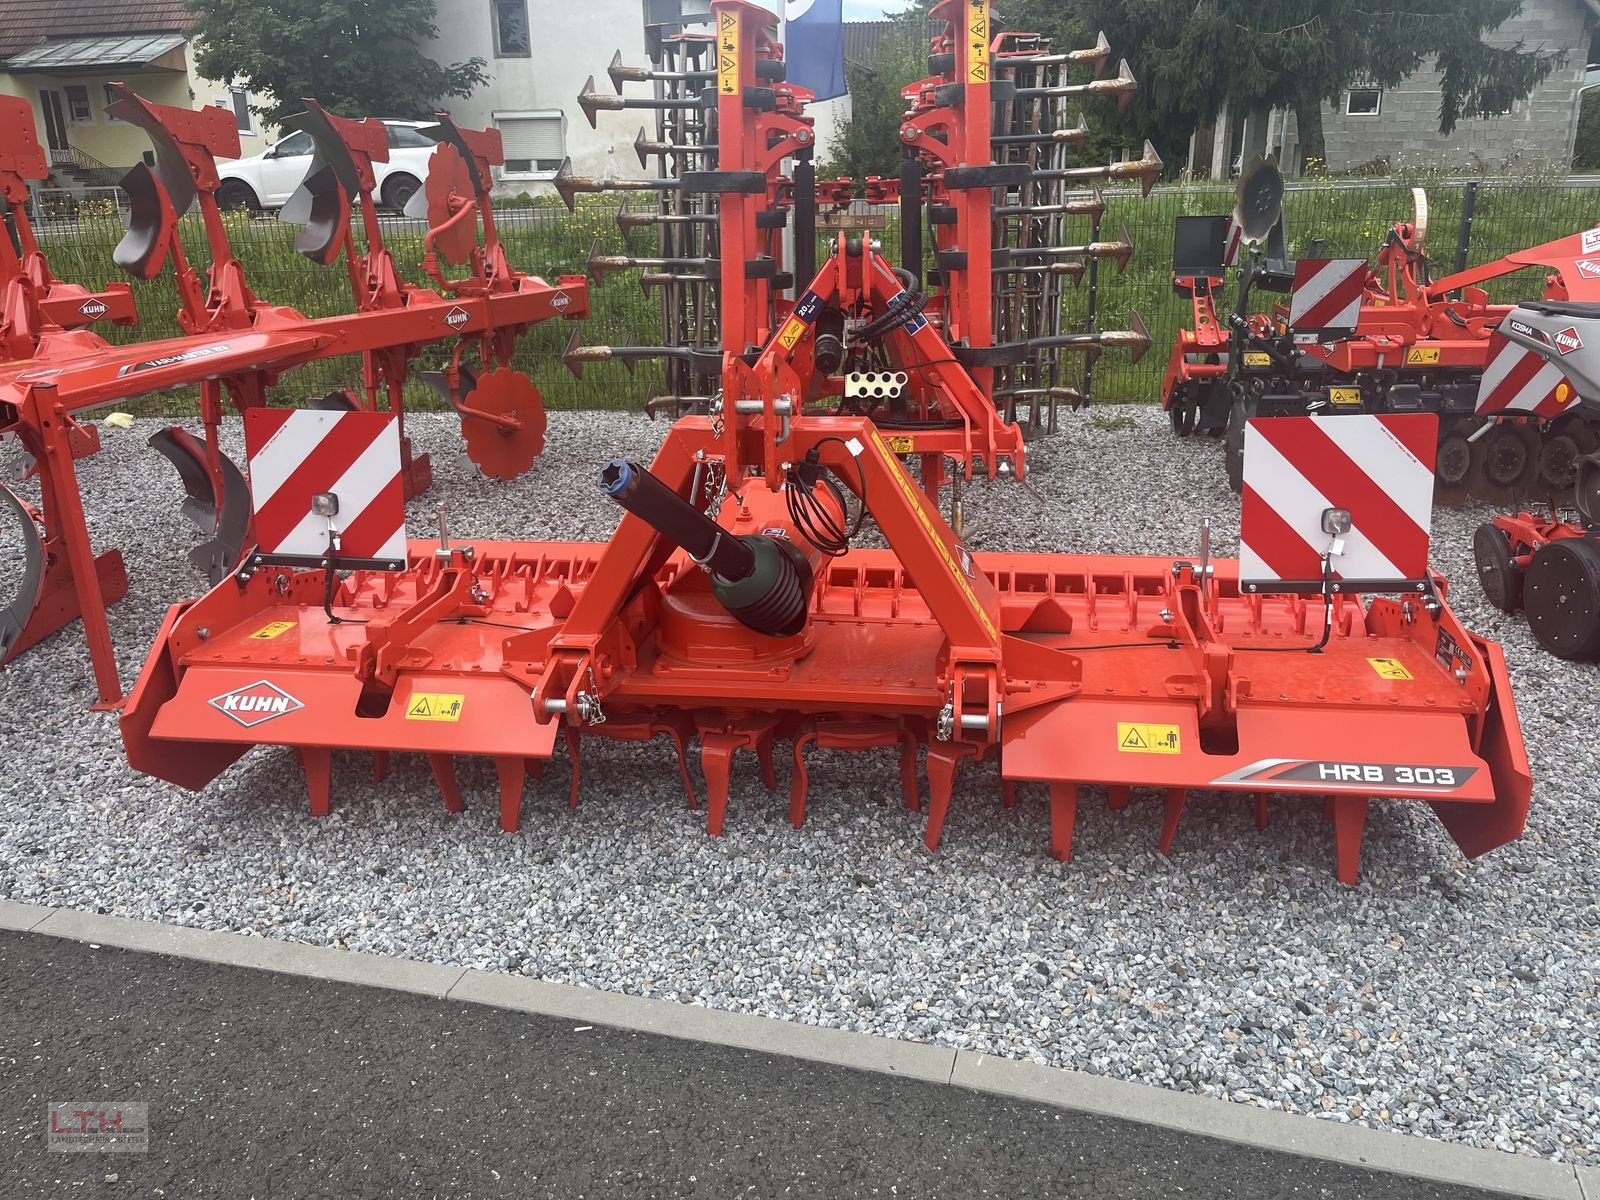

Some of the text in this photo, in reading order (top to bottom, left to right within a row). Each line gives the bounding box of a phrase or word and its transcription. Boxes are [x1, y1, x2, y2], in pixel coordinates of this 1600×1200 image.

[1585, 233, 1600, 247] LT
[1580, 260, 1600, 276] KUH
[83, 305, 106, 314] KUHN
[553, 297, 569, 307] KUHN
[798, 305, 808, 317] 20
[447, 313, 467, 325] KUHN
[1511, 320, 1533, 336] KOSMA
[1556, 332, 1579, 350] KUHN
[223, 695, 290, 712] KUHN
[1318, 763, 1456, 785] HRB 303
